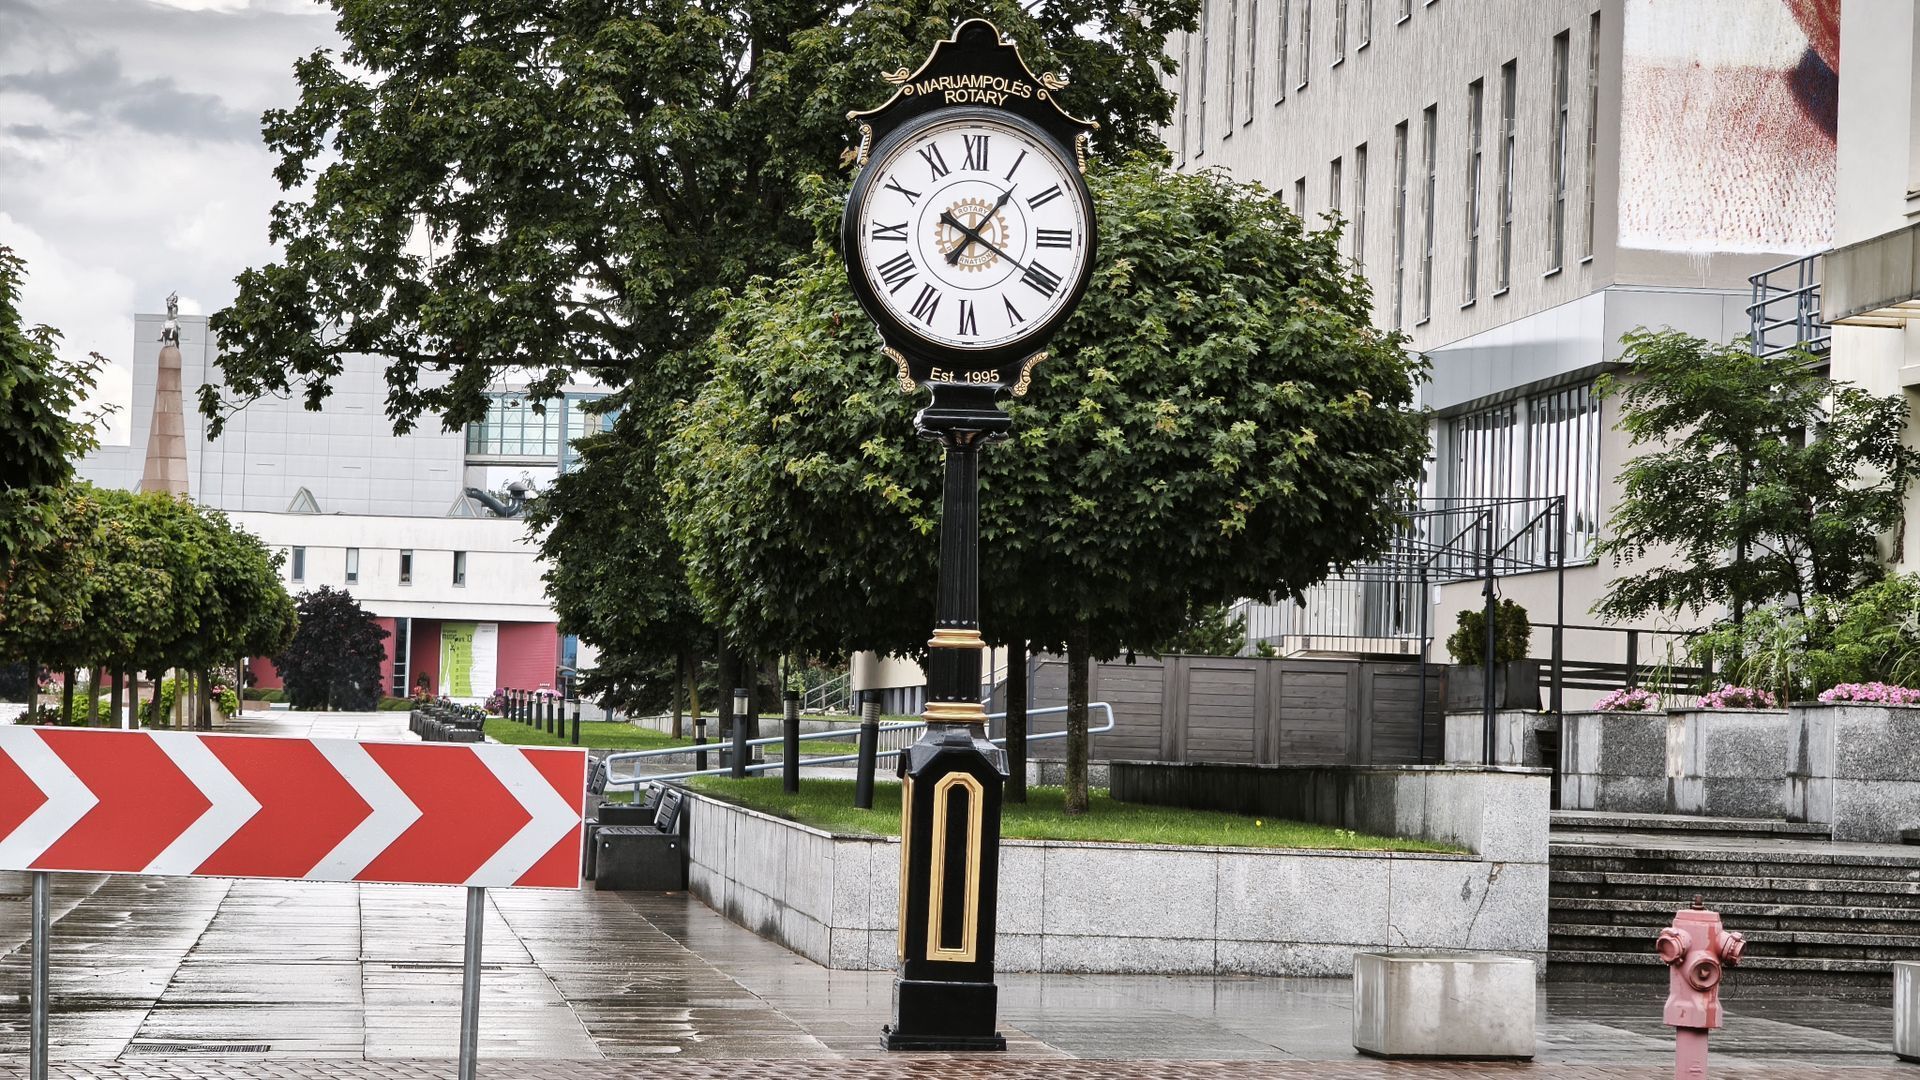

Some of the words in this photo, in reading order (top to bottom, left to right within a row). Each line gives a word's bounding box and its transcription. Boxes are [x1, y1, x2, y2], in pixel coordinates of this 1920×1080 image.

[916, 75, 1032, 98] MARIJAMPOLĖS
[945, 89, 1008, 106] ROTARY
[916, 141, 952, 182] XI
[960, 134, 991, 171] XII
[884, 175, 922, 207] X
[1026, 183, 1063, 211] II
[957, 206, 989, 215] ROTARY
[871, 219, 909, 242] IX
[1036, 227, 1072, 250] III
[876, 250, 920, 297] VIII
[907, 282, 943, 327] VII
[957, 299, 979, 336] VI
[1001, 292, 1026, 328] V
[930, 367, 957, 383] Est.
[964, 369, 1000, 384] 1995
